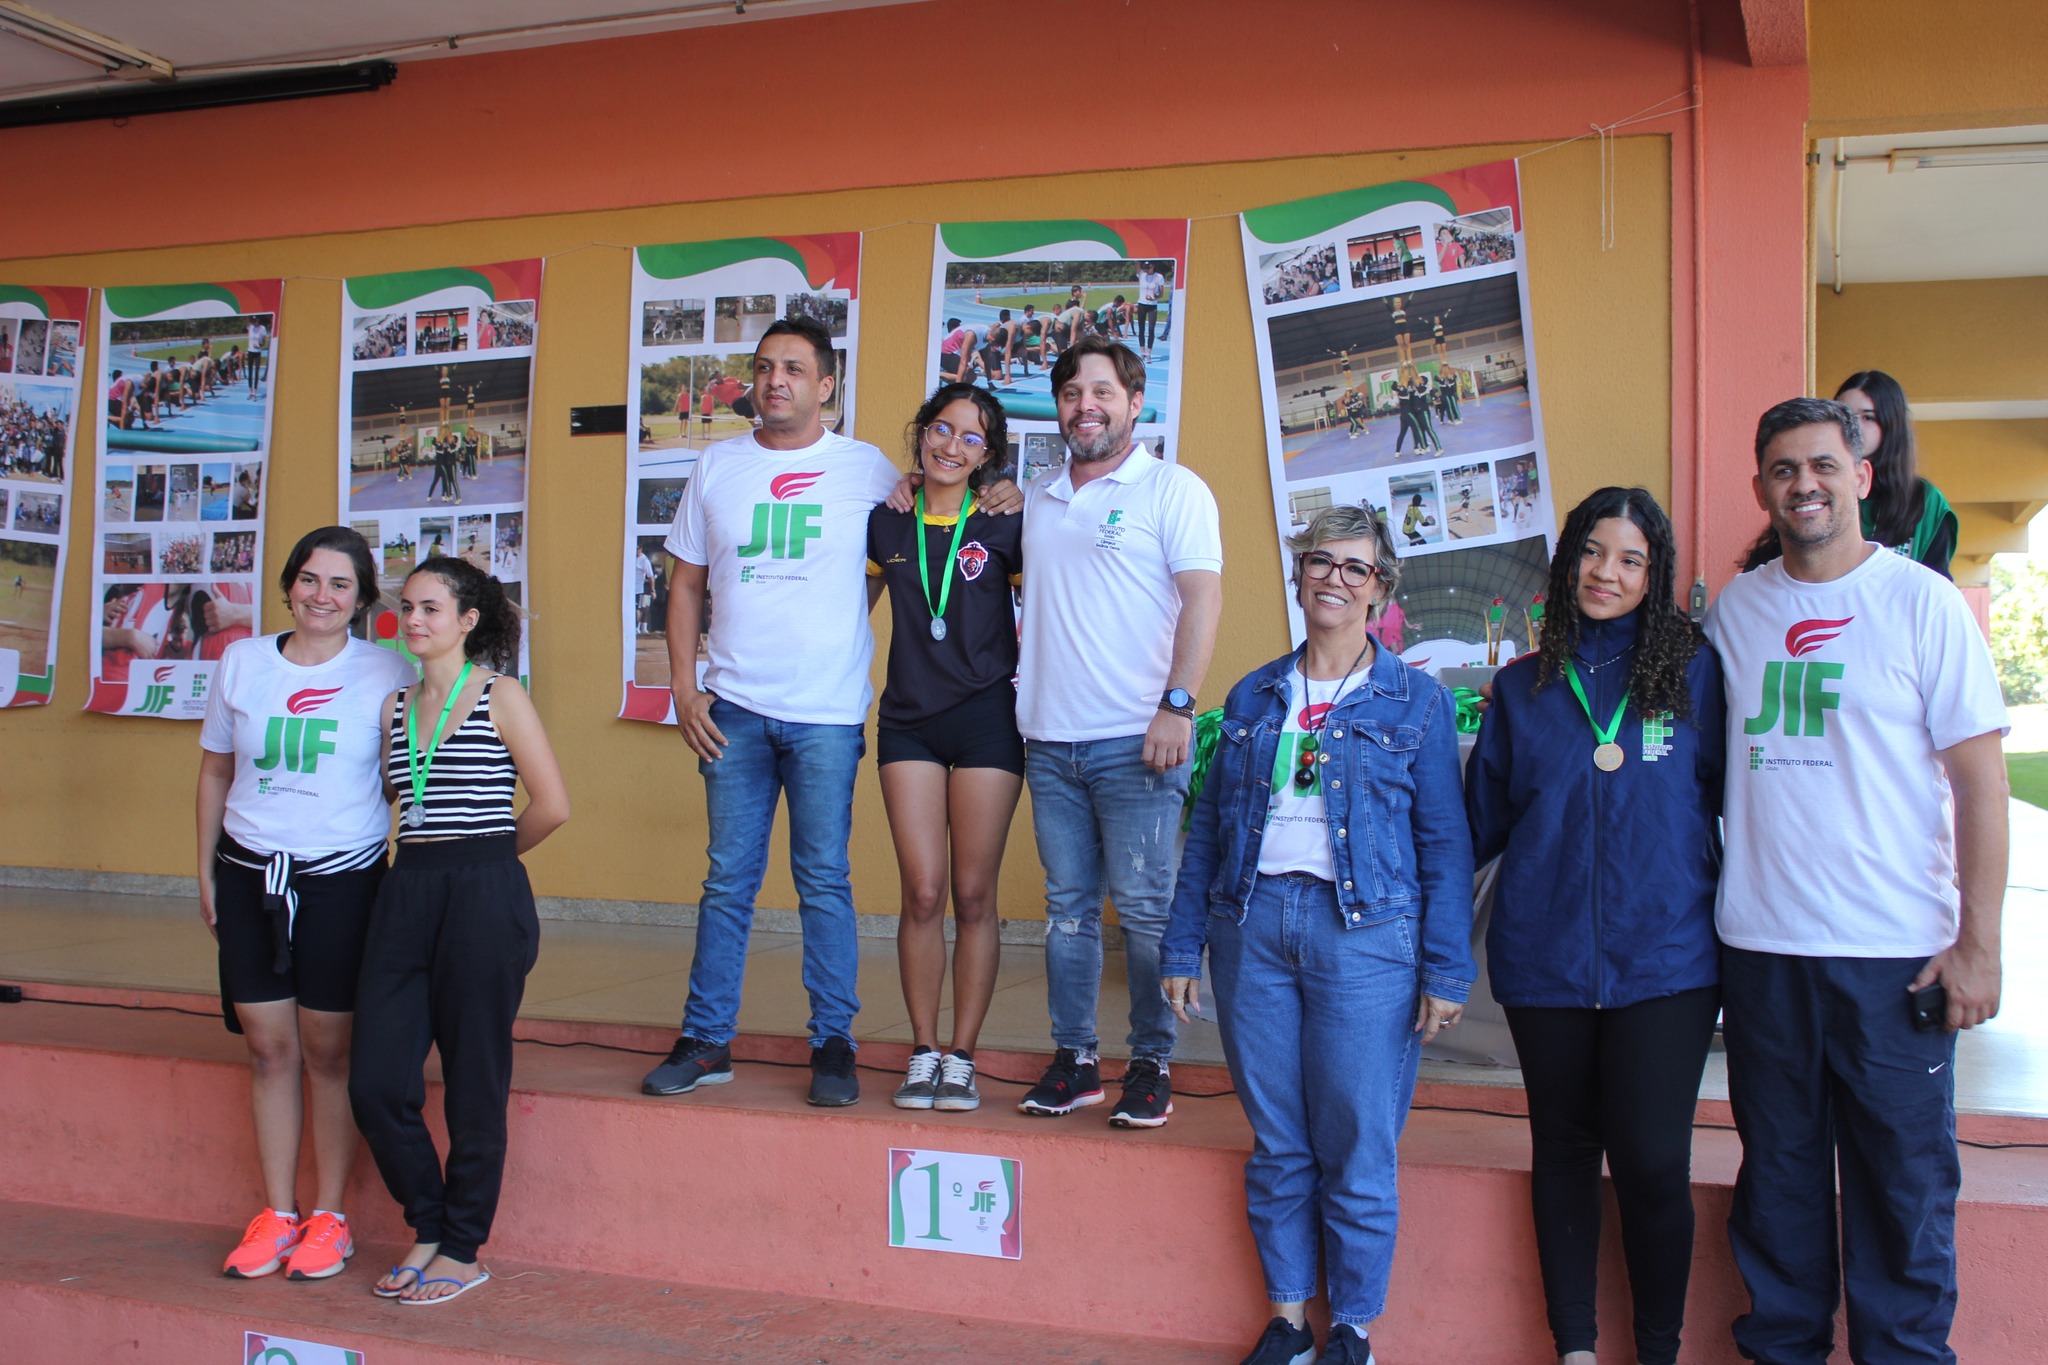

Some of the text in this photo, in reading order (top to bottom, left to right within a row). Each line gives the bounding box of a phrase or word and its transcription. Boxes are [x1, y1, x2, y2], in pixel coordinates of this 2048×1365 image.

[737, 503, 823, 559] JIF
[1098, 524, 1126, 533] INSTITUTO
[132, 685, 175, 713] JIF
[1743, 661, 1845, 737] JIF
[253, 716, 339, 775] JIF
[1765, 758, 1834, 767] INSTITUTO FEDERAL
[968, 1191, 997, 1213] JIF
